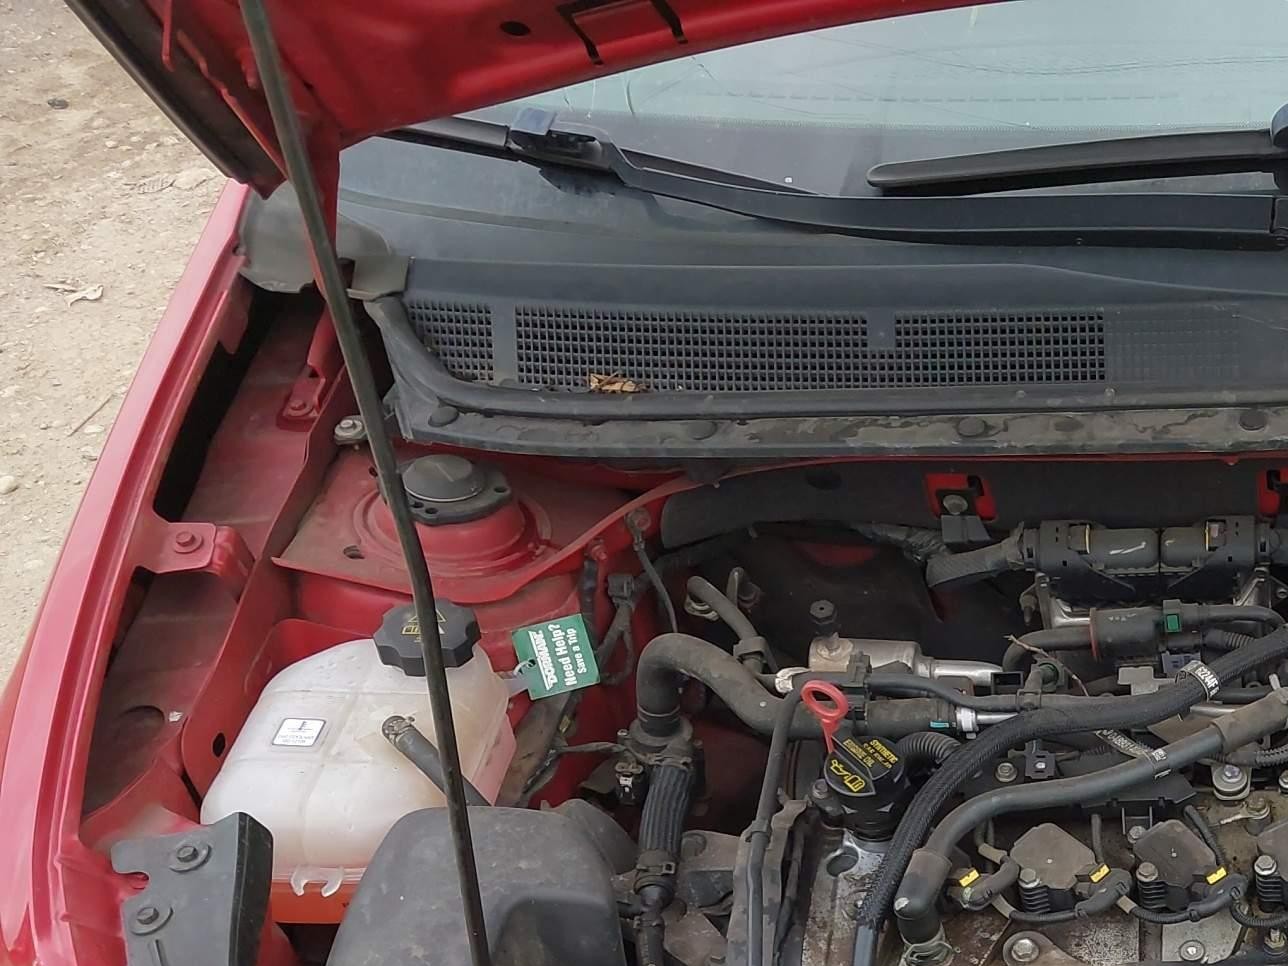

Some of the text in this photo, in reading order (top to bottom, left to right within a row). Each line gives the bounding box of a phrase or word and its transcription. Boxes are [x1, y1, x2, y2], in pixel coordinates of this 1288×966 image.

[566, 628, 578, 646] Trip
[547, 624, 577, 686] Need Help?
[574, 653, 587, 674] Save
